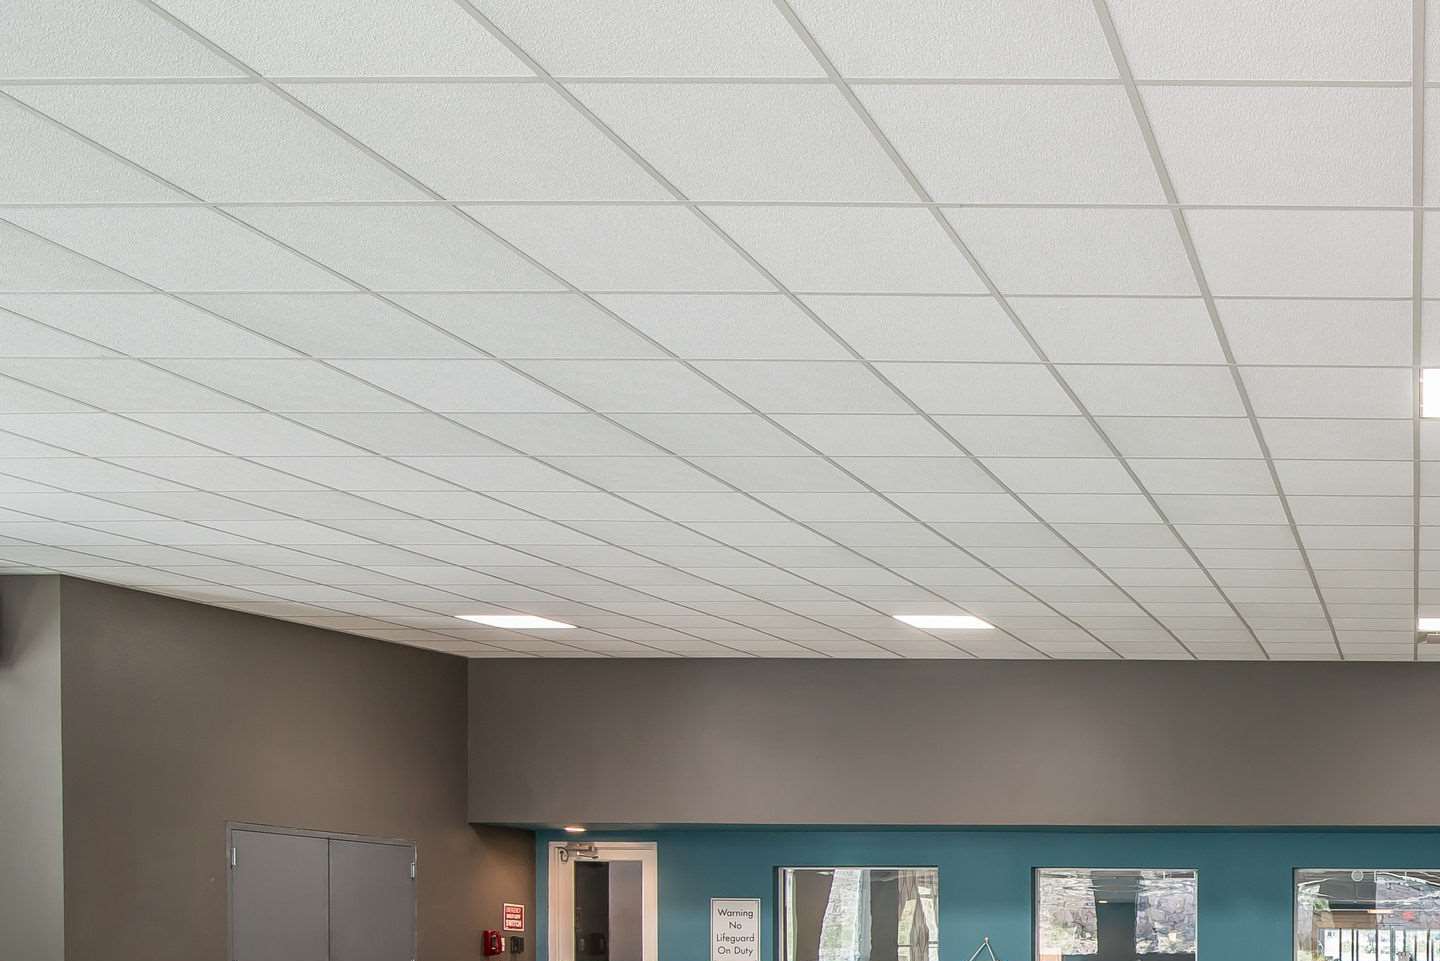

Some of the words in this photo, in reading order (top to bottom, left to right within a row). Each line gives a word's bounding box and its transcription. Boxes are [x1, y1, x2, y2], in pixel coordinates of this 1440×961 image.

[717, 908, 754, 919] Warning
[728, 921, 743, 930] No
[716, 932, 755, 945] Lifeguard
[717, 946, 731, 955] On
[734, 946, 754, 957] Duty
